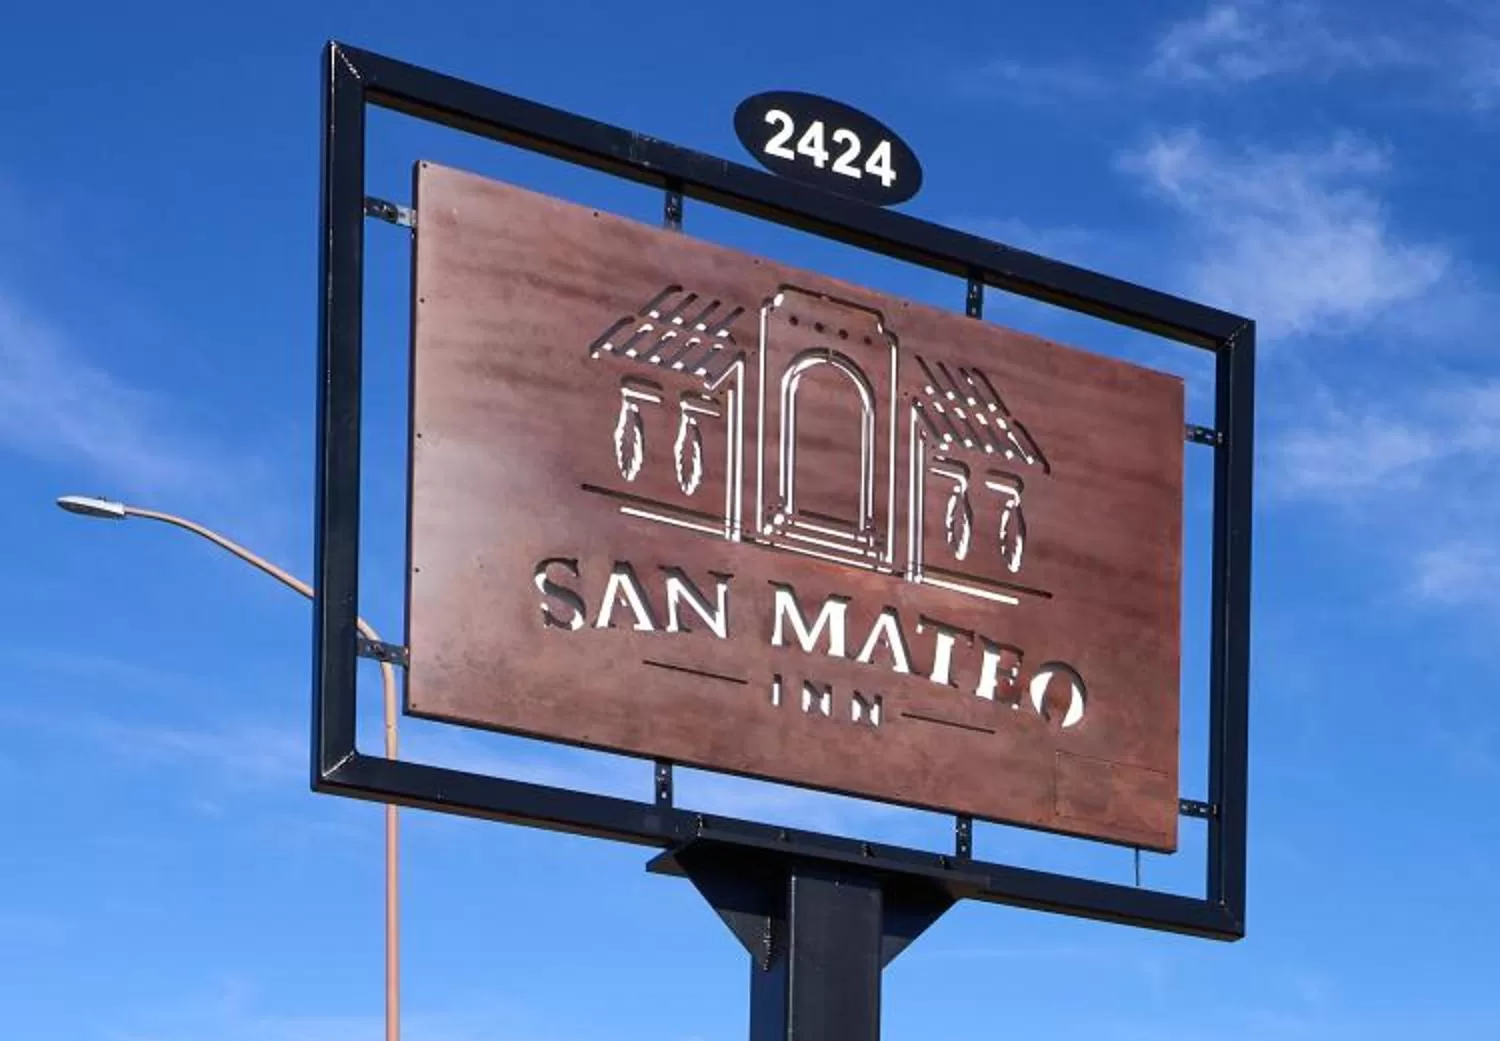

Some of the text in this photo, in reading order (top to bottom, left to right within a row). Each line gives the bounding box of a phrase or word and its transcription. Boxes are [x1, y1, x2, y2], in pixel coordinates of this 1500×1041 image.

[764, 109, 897, 188] 2424
[534, 557, 1087, 728] SAN MATEO
[773, 673, 882, 727] INN
